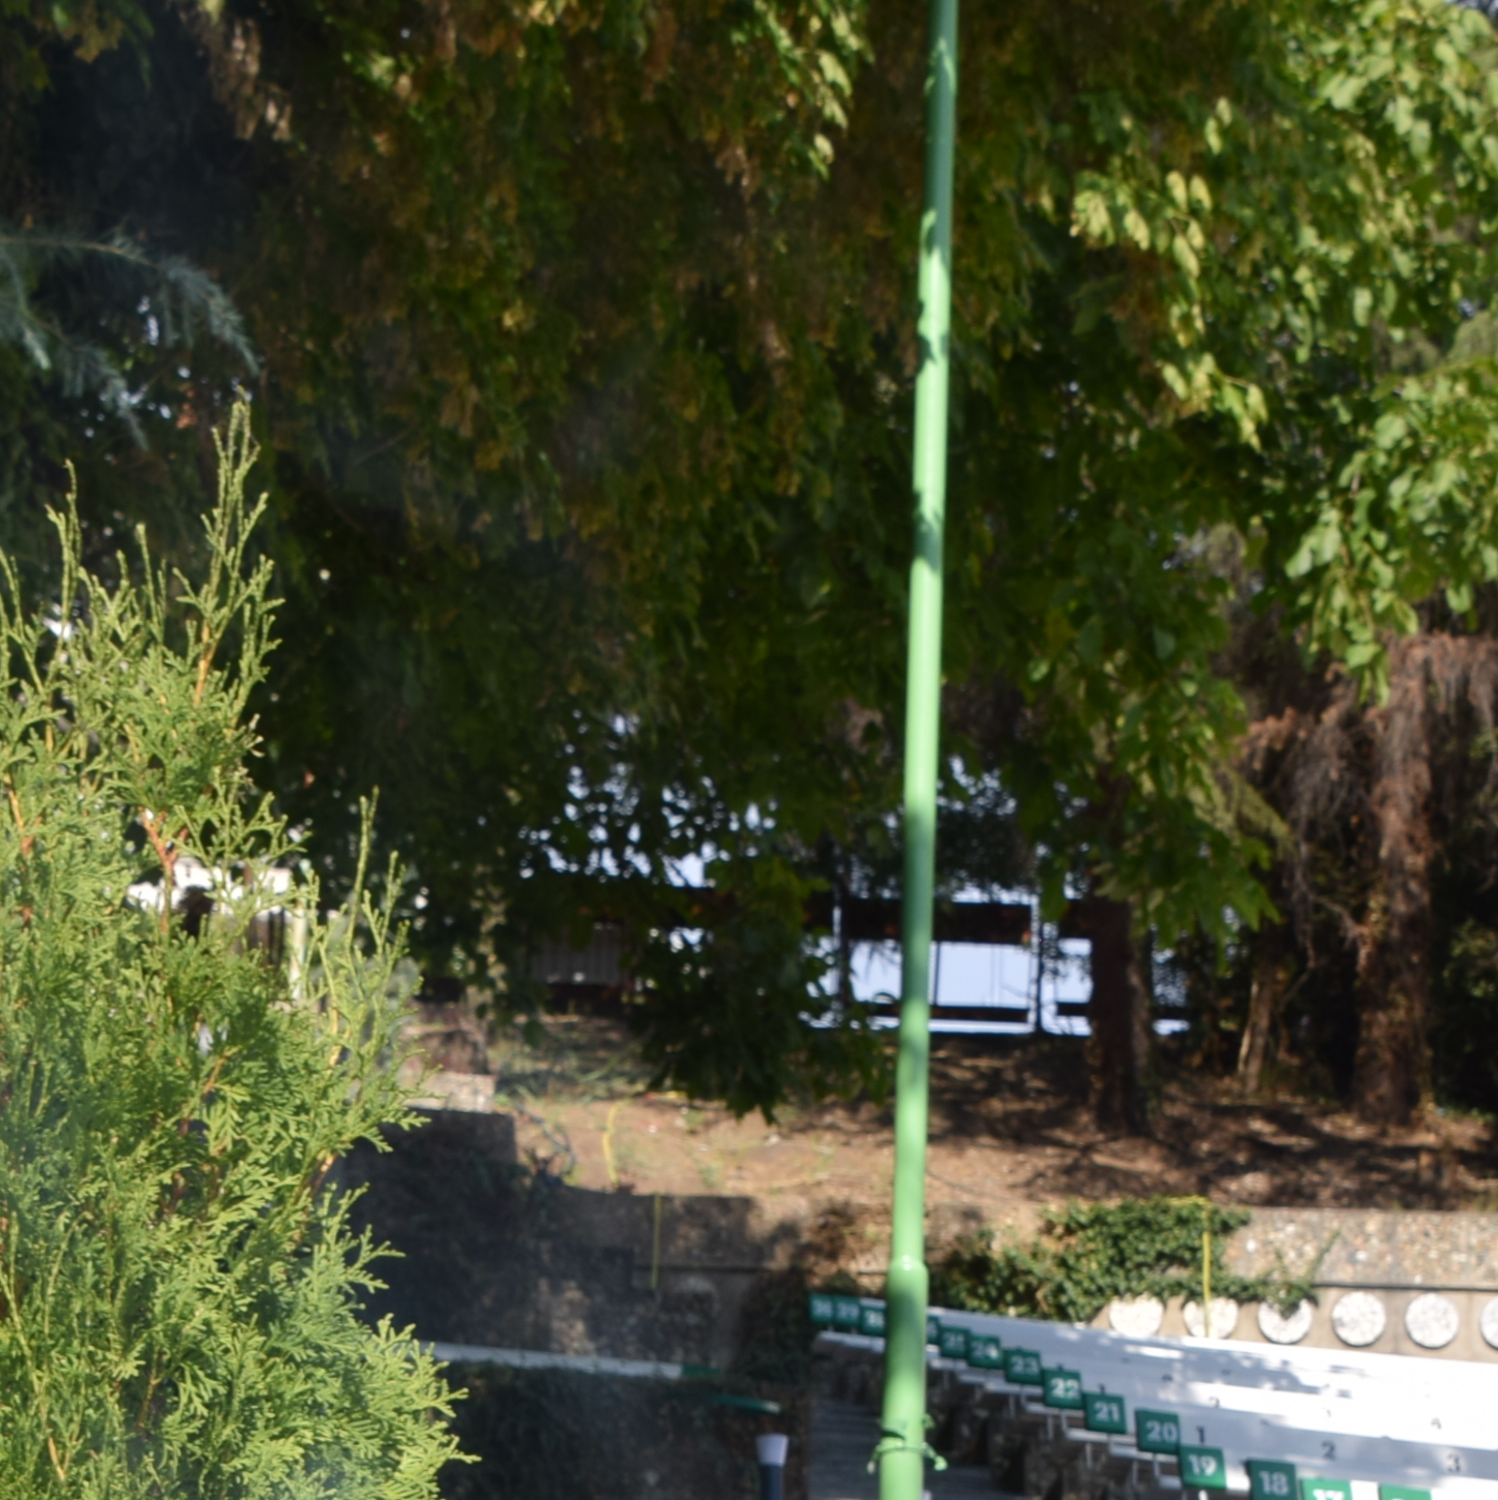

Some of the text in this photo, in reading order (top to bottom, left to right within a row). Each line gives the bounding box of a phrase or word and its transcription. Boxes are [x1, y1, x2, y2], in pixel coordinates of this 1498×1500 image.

[1010, 1355, 1039, 1373] 23
[1051, 1377, 1080, 1398] 22
[1094, 1401, 1120, 1422] 21
[1146, 1420, 1178, 1442] 20
[1196, 1425, 1205, 1444] 1
[1321, 1441, 1336, 1460] 2
[1189, 1454, 1217, 1476] 19
[1447, 1453, 1461, 1473] 3
[1259, 1471, 1288, 1495] 18
